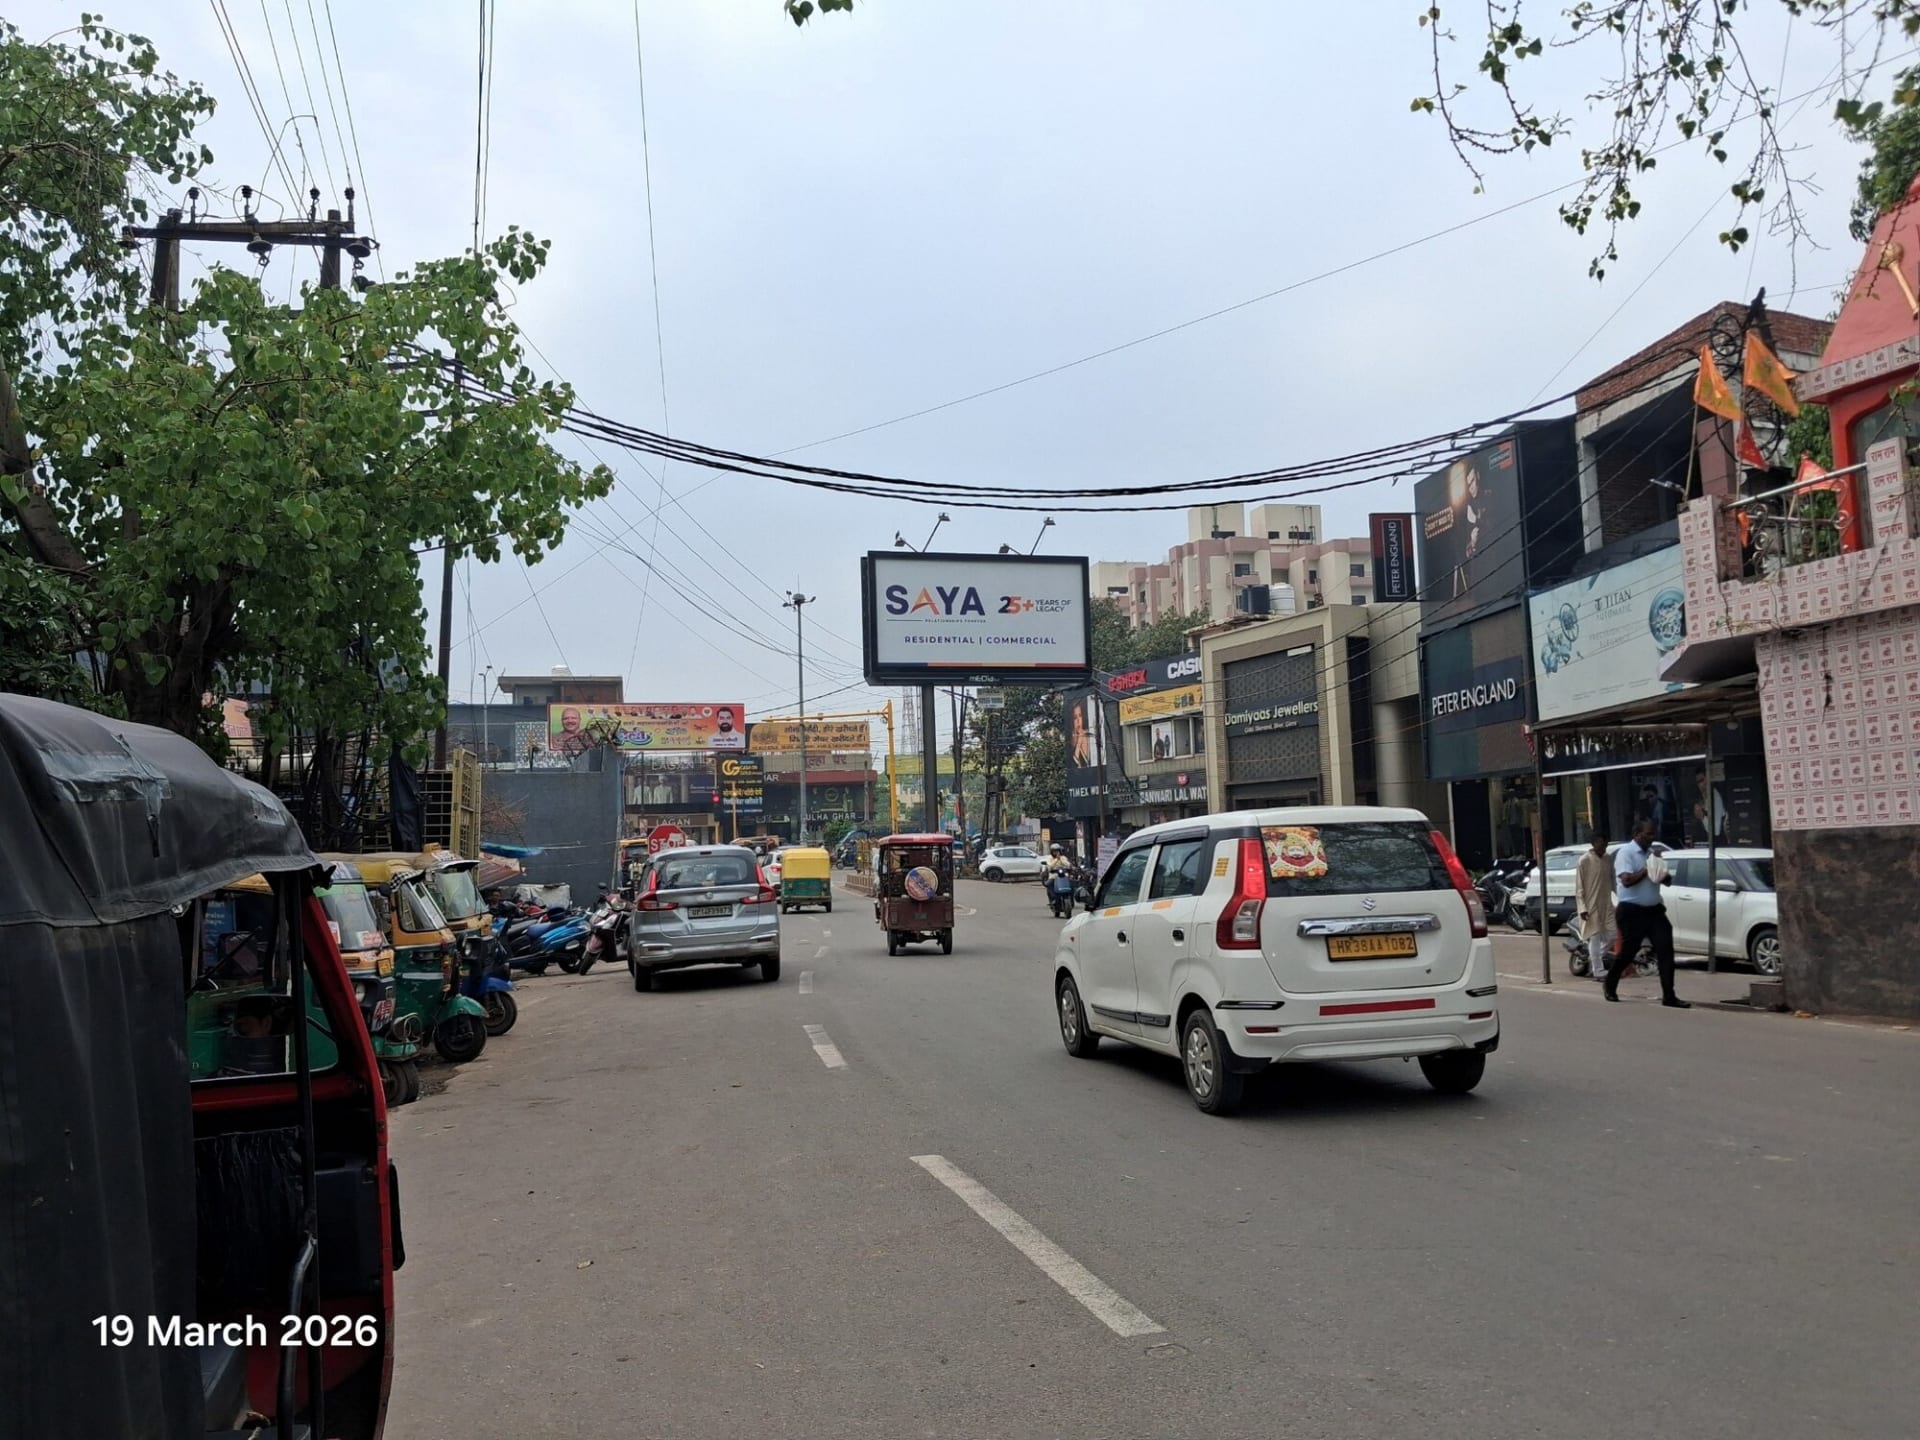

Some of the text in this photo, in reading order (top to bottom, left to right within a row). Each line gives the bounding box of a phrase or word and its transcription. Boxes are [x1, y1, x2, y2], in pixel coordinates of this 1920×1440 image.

[1391, 521, 1402, 596] PETER ENGLAND
[886, 585, 985, 616] SAYA
[998, 596, 1034, 614] 25+
[1603, 589, 1632, 609] TITAN
[905, 636, 1057, 645] RESIDENTIAL COMMERCIAL
[1167, 657, 1203, 679] CASI
[1108, 669, 1147, 692] G-SHOCK
[1432, 678, 1516, 717] PETER ENGLAND
[1225, 701, 1319, 726] Damiyaas Jewellers
[652, 760, 694, 771] LAGAN
[1069, 786, 1089, 798] TIMEX
[1140, 789, 1173, 804] BANWARI
[1173, 788, 1189, 801] LAL
[656, 816, 691, 825] LAGAN
[832, 812, 856, 820] GHAR
